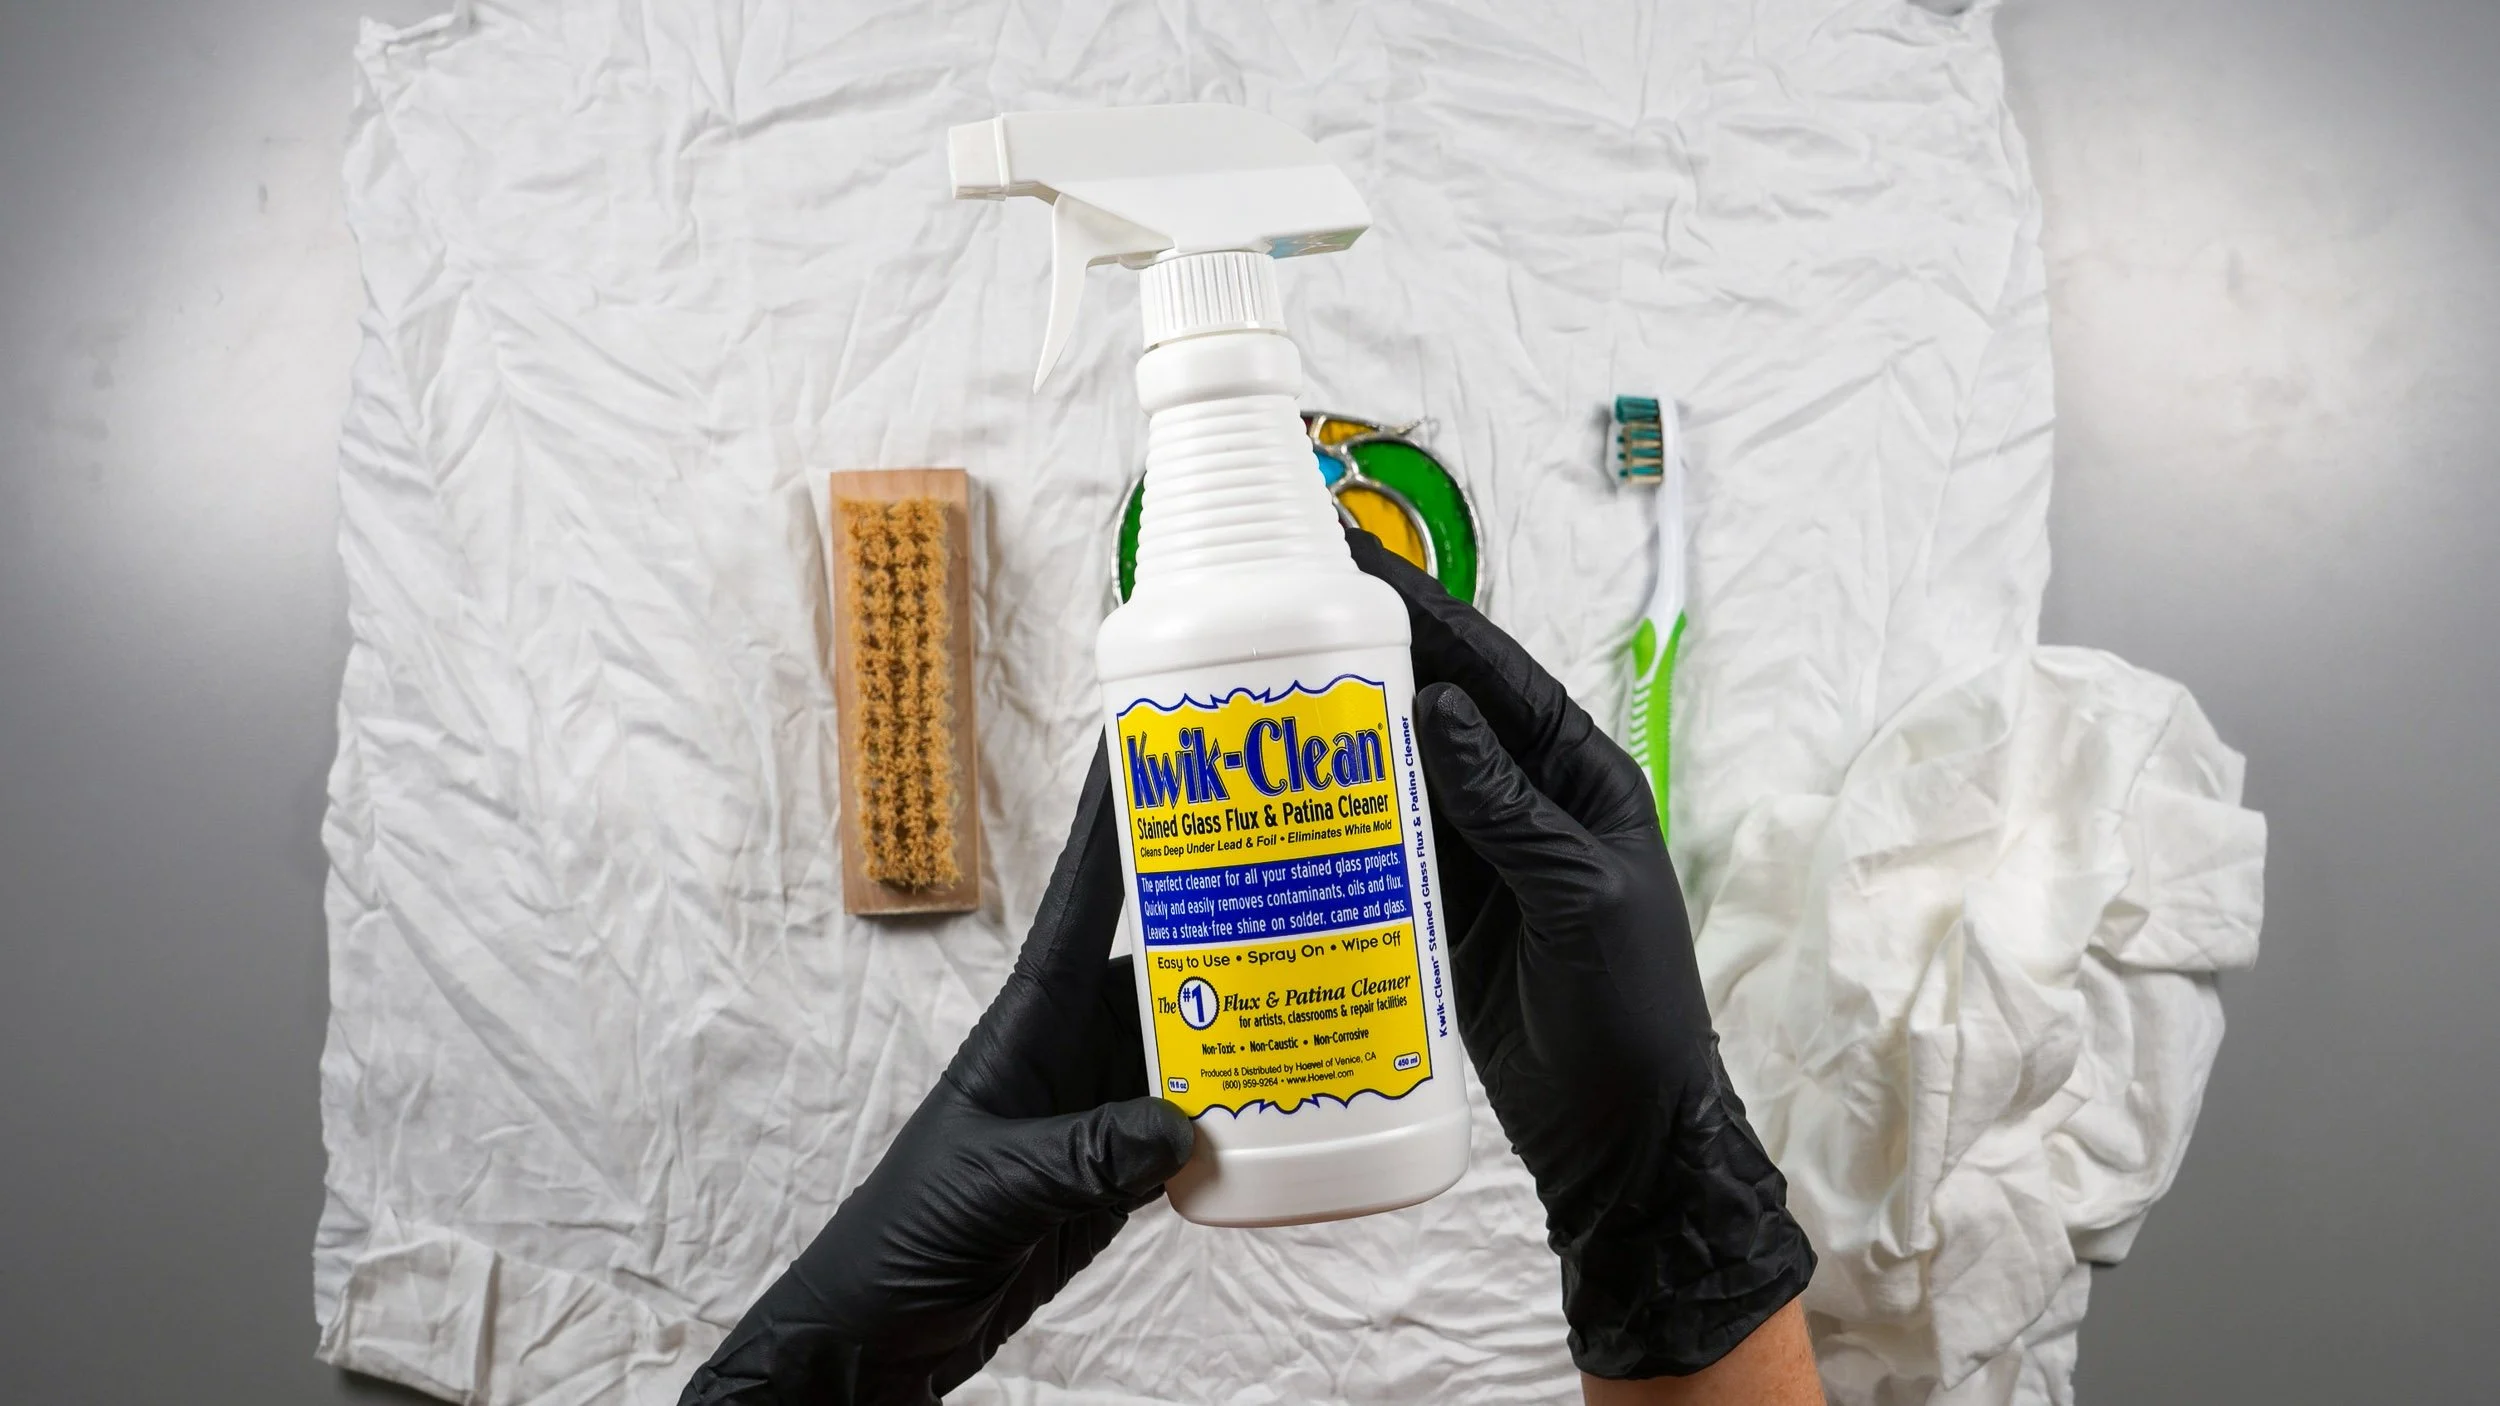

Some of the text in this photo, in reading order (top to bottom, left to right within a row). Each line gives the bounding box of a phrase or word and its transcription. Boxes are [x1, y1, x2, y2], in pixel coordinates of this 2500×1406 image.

[1401, 716, 1414, 766] Cleaner
[1408, 770, 1419, 812] Patina
[1137, 793, 1389, 840] Stained Glass Flux & Patina Cleaner
[1413, 816, 1421, 827] &
[1140, 819, 1392, 858] Cleans Deep Under Lead & Foil Eliminates White Mold
[1416, 830, 1425, 857] Flux
[1141, 850, 1400, 896] The perfect cleaner for all your stained glass projects.
[1420, 861, 1431, 897] Glass
[1144, 900, 1168, 920] Quickly
[1170, 899, 1186, 915] and
[1188, 897, 1215, 917] easily
[1218, 895, 1264, 911] removes
[1347, 879, 1365, 897] oils
[1368, 876, 1385, 894] and
[1386, 874, 1404, 890] flux.
[1147, 924, 1170, 940] Leaves
[1172, 926, 1178, 939] a
[1180, 920, 1233, 938] streak-free
[1237, 917, 1266, 934] shine
[1271, 917, 1286, 931] on
[1330, 907, 1359, 923] came
[1363, 901, 1381, 919] and
[1383, 898, 1407, 919] glass.
[1423, 901, 1437, 951] Stained
[1157, 930, 1401, 972] Easy to Use Spray On Wipe Off
[1157, 997, 1176, 1014] The
[1223, 993, 1261, 1012] Flux
[1265, 991, 1280, 1009] &
[1285, 986, 1346, 1007] Patina
[1351, 975, 1411, 998] Cleaner
[1239, 994, 1408, 1029] for artists, classrooms & repair facilities
[1201, 1027, 1369, 1055] Non-Toxic Non-Caustic Non-Corrosive
[1200, 1051, 1377, 1078] Produced & Distributed by Hoevel of Venice, CA
[1286, 1069, 1354, 1085] www.Hoevel.com
